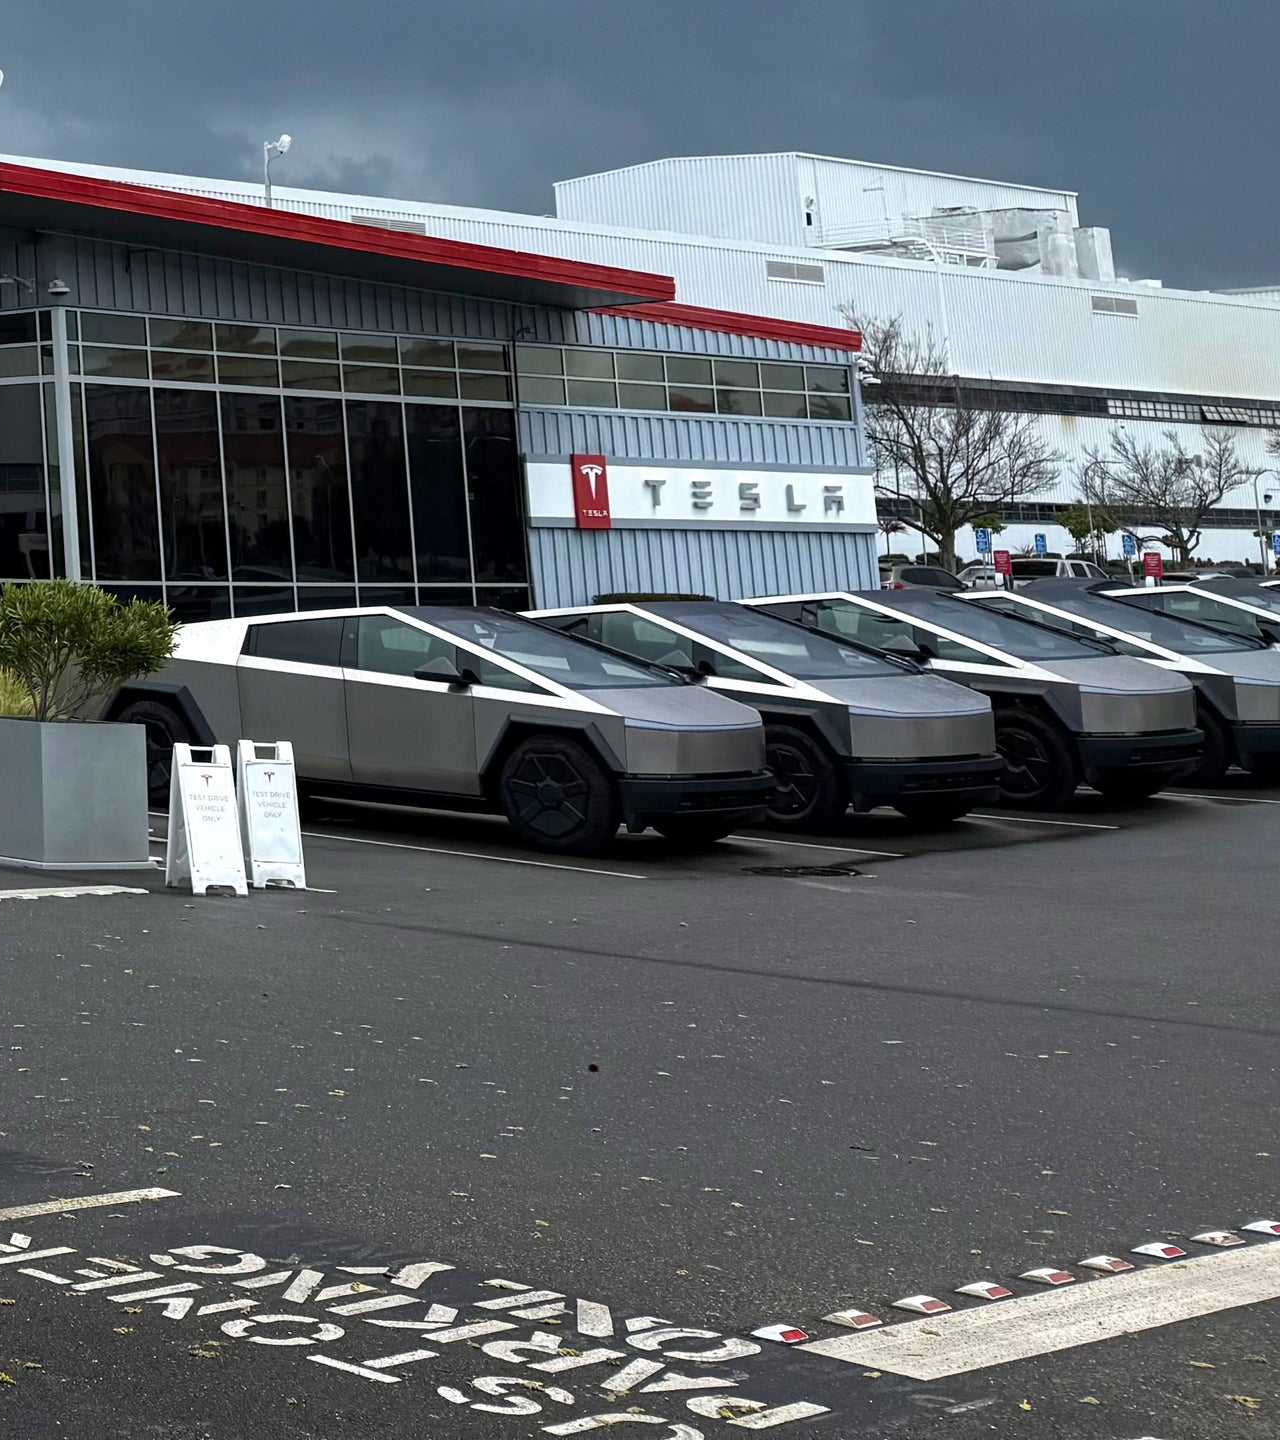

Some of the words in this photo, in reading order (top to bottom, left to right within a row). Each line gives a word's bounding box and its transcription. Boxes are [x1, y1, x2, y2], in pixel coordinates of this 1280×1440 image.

[644, 479, 844, 513] TESLA
[582, 509, 608, 517] TESLA
[208, 794, 229, 802] DRIVE
[270, 791, 290, 799] DRIVE
[335, 1261, 762, 1362] ONLY
[149, 1245, 831, 1429] PARKING
